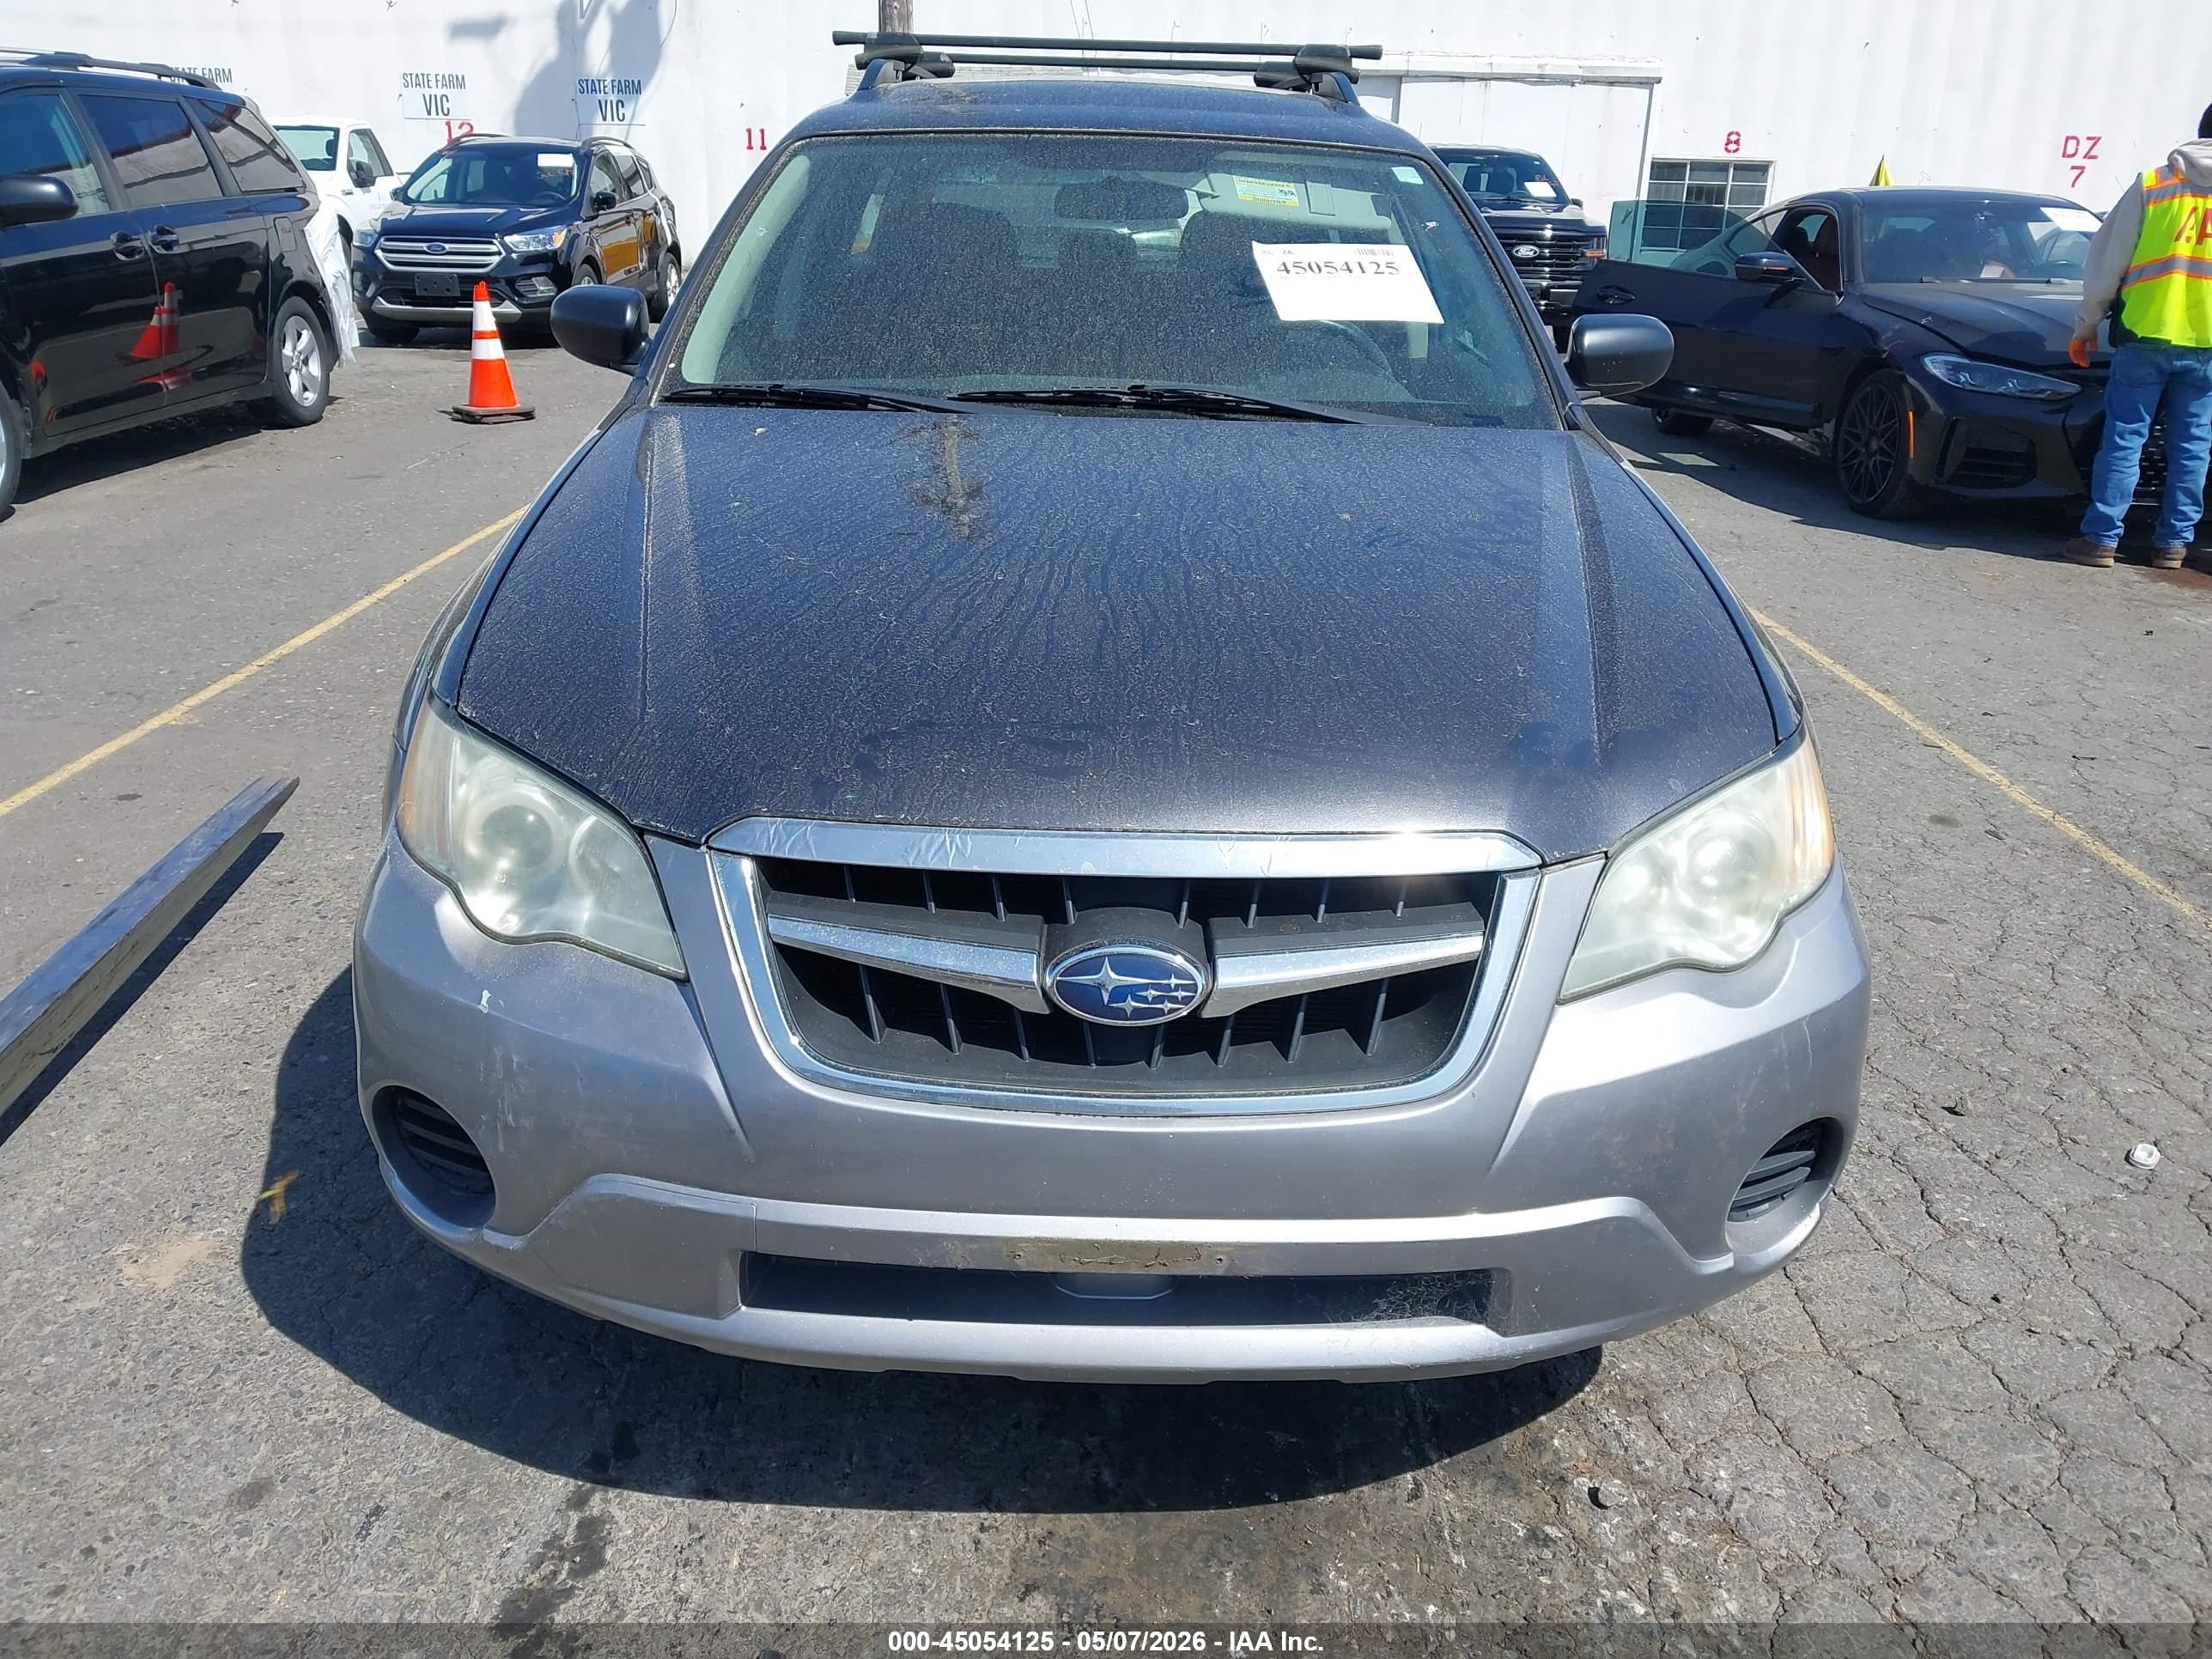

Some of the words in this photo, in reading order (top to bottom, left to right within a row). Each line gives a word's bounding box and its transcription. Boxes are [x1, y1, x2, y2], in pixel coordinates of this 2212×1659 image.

[201, 67, 233, 83] FARM
[402, 72, 434, 89] STATE
[434, 73, 466, 90] FARM
[577, 78, 609, 95] STATE
[611, 79, 642, 95] FARM
[422, 93, 451, 117] VIC
[598, 99, 626, 122] VIC
[745, 127, 768, 151] 11
[1724, 131, 1741, 154] 8
[2062, 135, 2103, 160] DZ
[2069, 165, 2087, 188] 7
[1277, 261, 1401, 276] 45054125
